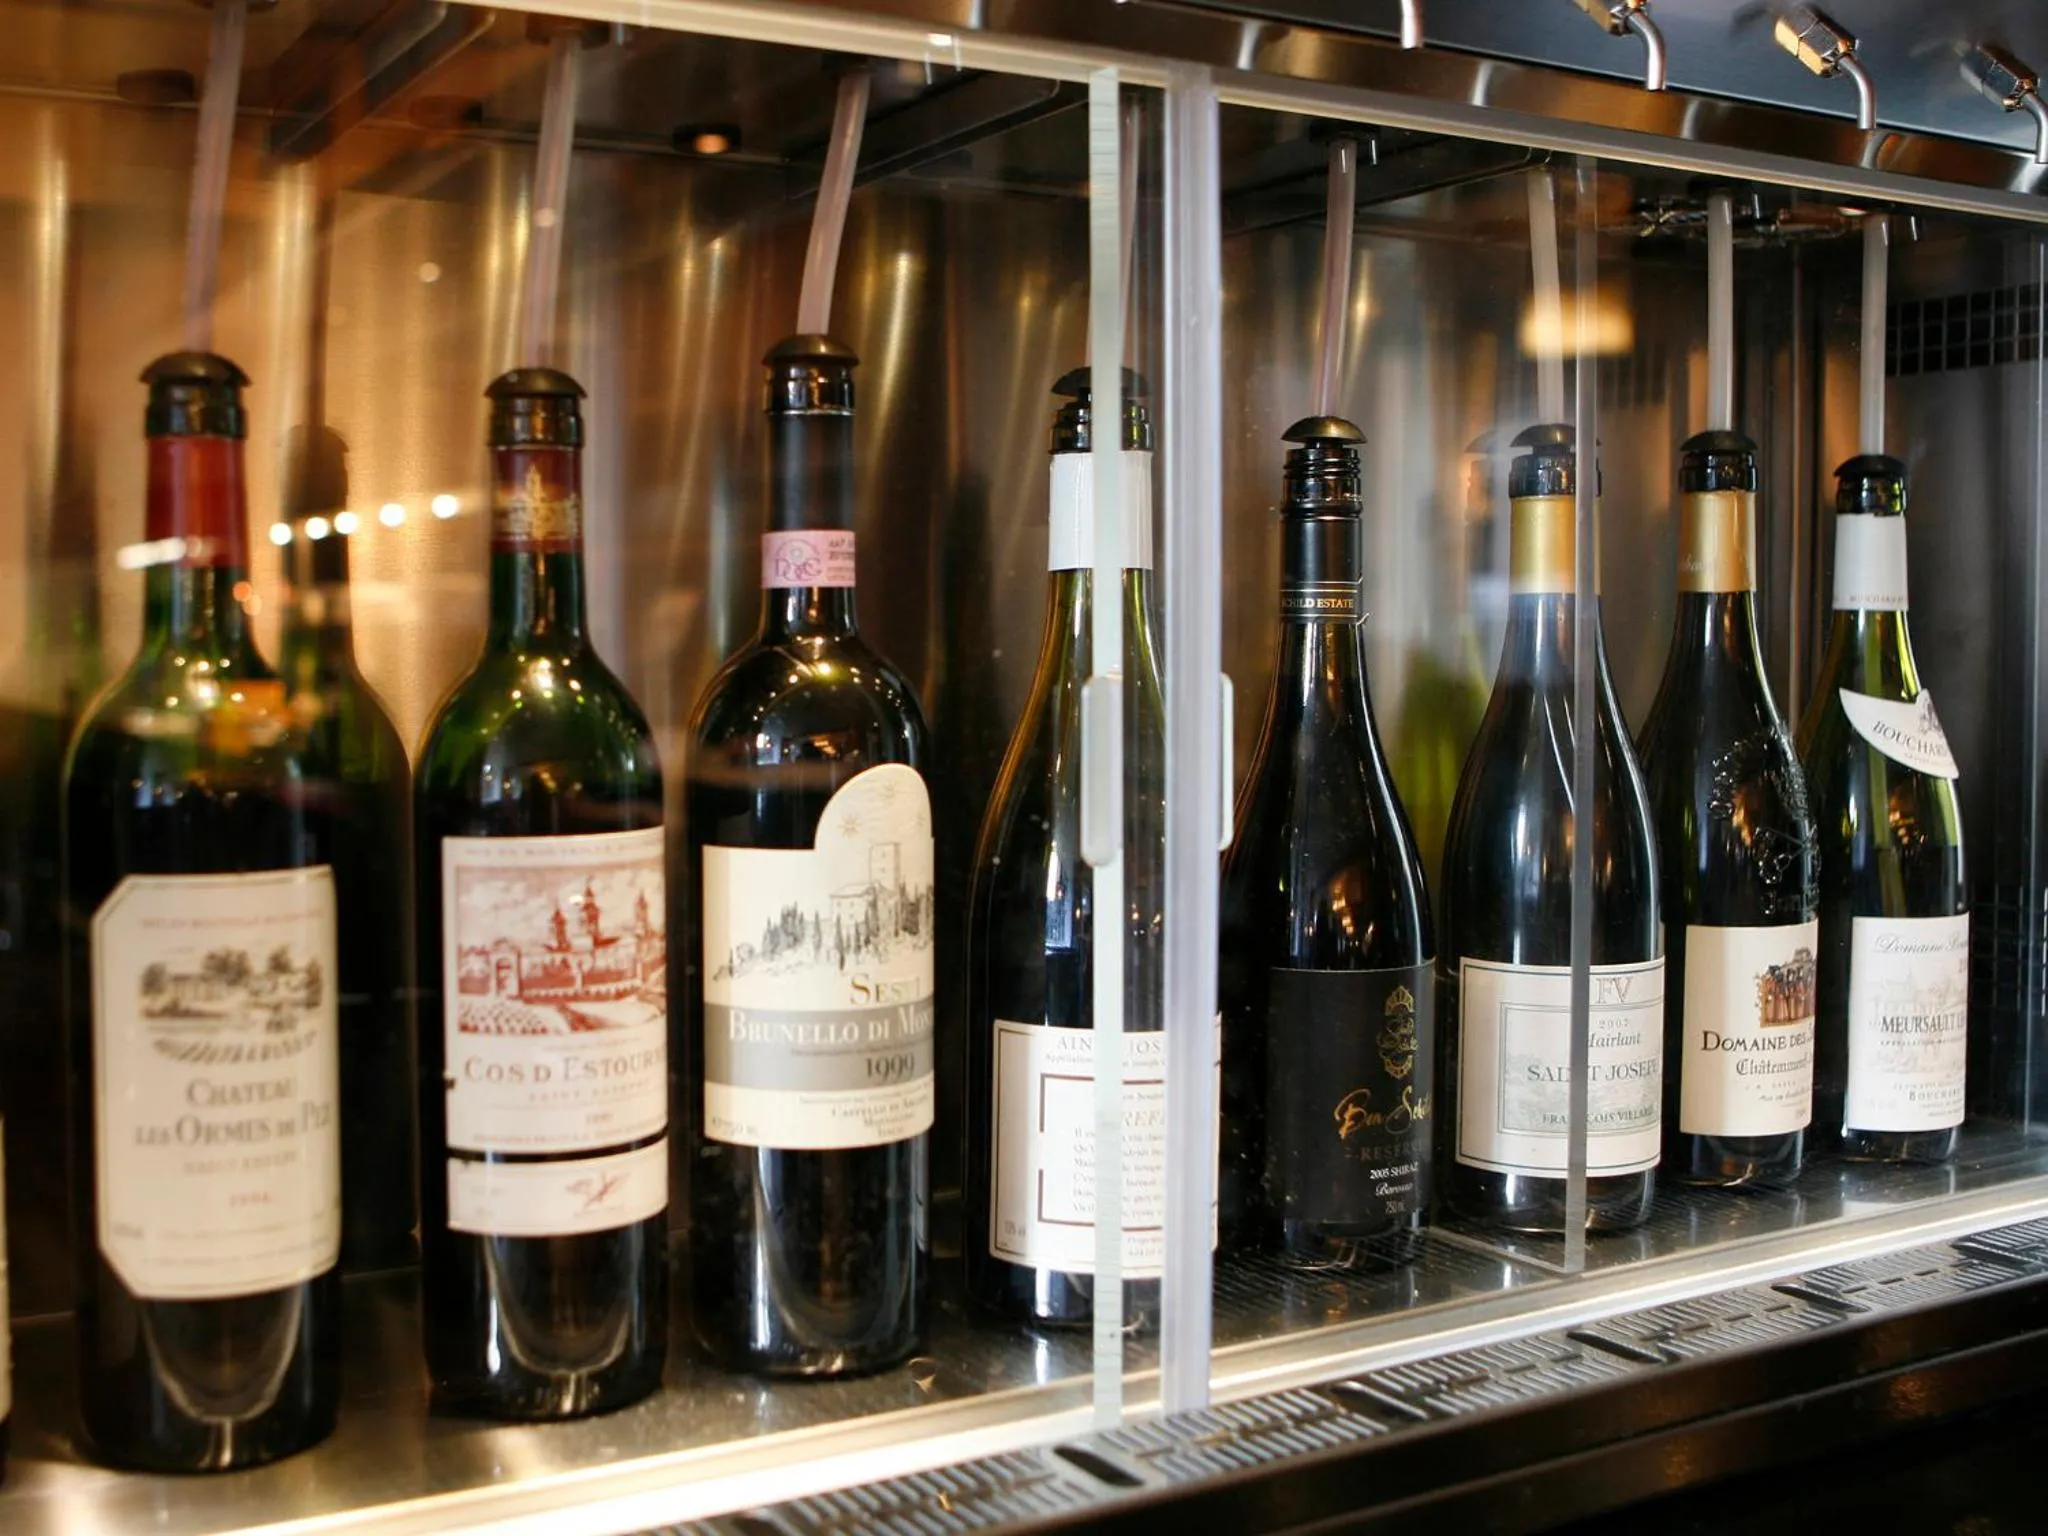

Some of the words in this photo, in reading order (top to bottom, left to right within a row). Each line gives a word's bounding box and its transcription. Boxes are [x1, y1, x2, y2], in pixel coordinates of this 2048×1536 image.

[1317, 597, 1354, 608] ESTATE
[1595, 975, 1634, 1004] FV
[729, 1007, 859, 1045] BRUNELLO
[869, 1019, 890, 1041] DI
[898, 1003, 934, 1038] MON
[1880, 1013, 1955, 1034] MEURSAULT
[1701, 1029, 1787, 1052] DOMAINE
[464, 1054, 524, 1083] COS
[865, 1052, 916, 1081] 1999
[1527, 1063, 1602, 1083] SAIT
[1369, 1167, 1390, 1180] 2005
[1390, 1161, 1419, 1178] SHIRAZ
